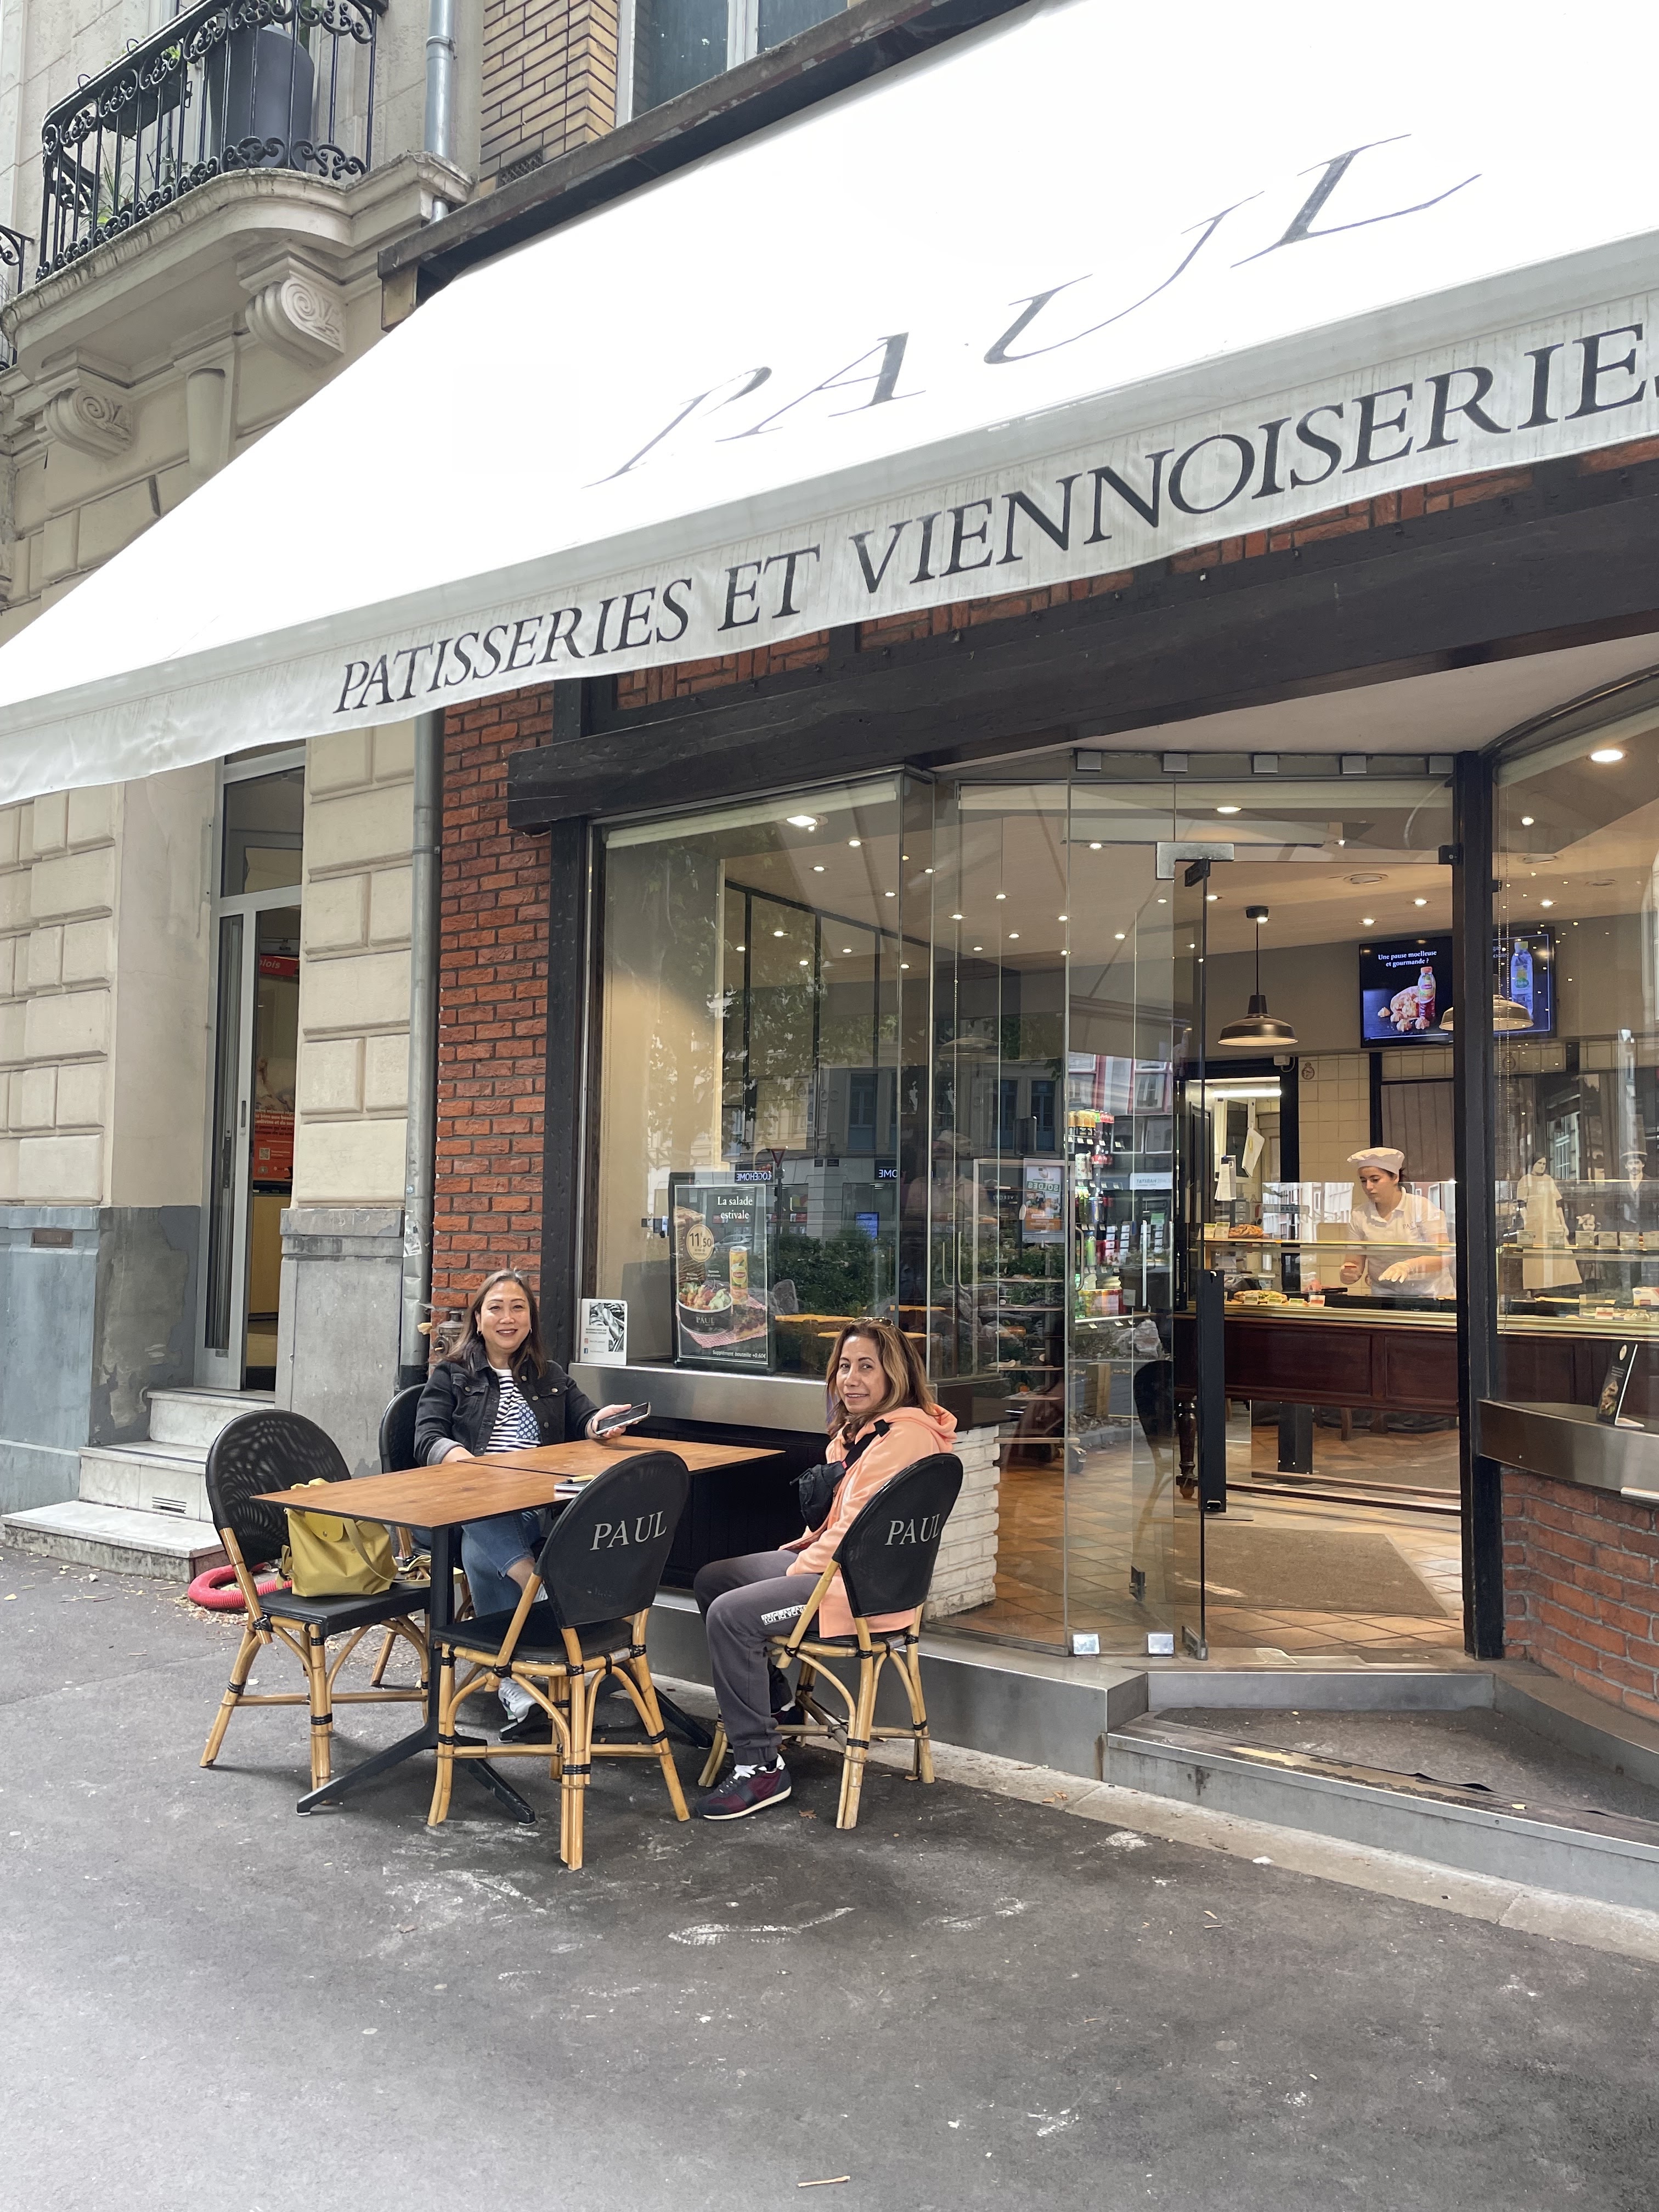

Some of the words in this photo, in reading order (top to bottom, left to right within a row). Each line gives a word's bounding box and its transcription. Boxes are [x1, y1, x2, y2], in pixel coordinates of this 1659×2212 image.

[581, 133, 1482, 489] PAUL
[332, 578, 692, 714] PATISSERIES
[718, 544, 821, 632] ET
[849, 323, 1659, 595] VIENNOISERIE
[1392, 958, 1425, 968] gourmande
[717, 1196, 727, 1206] La
[729, 1195, 753, 1206] salade
[720, 1209, 749, 1220] estivale
[696, 1316, 715, 1324] PAUL
[589, 1510, 667, 1551] PAUL
[884, 1513, 940, 1545] PAUL
[763, 1605, 807, 1624] APAPIJRI
